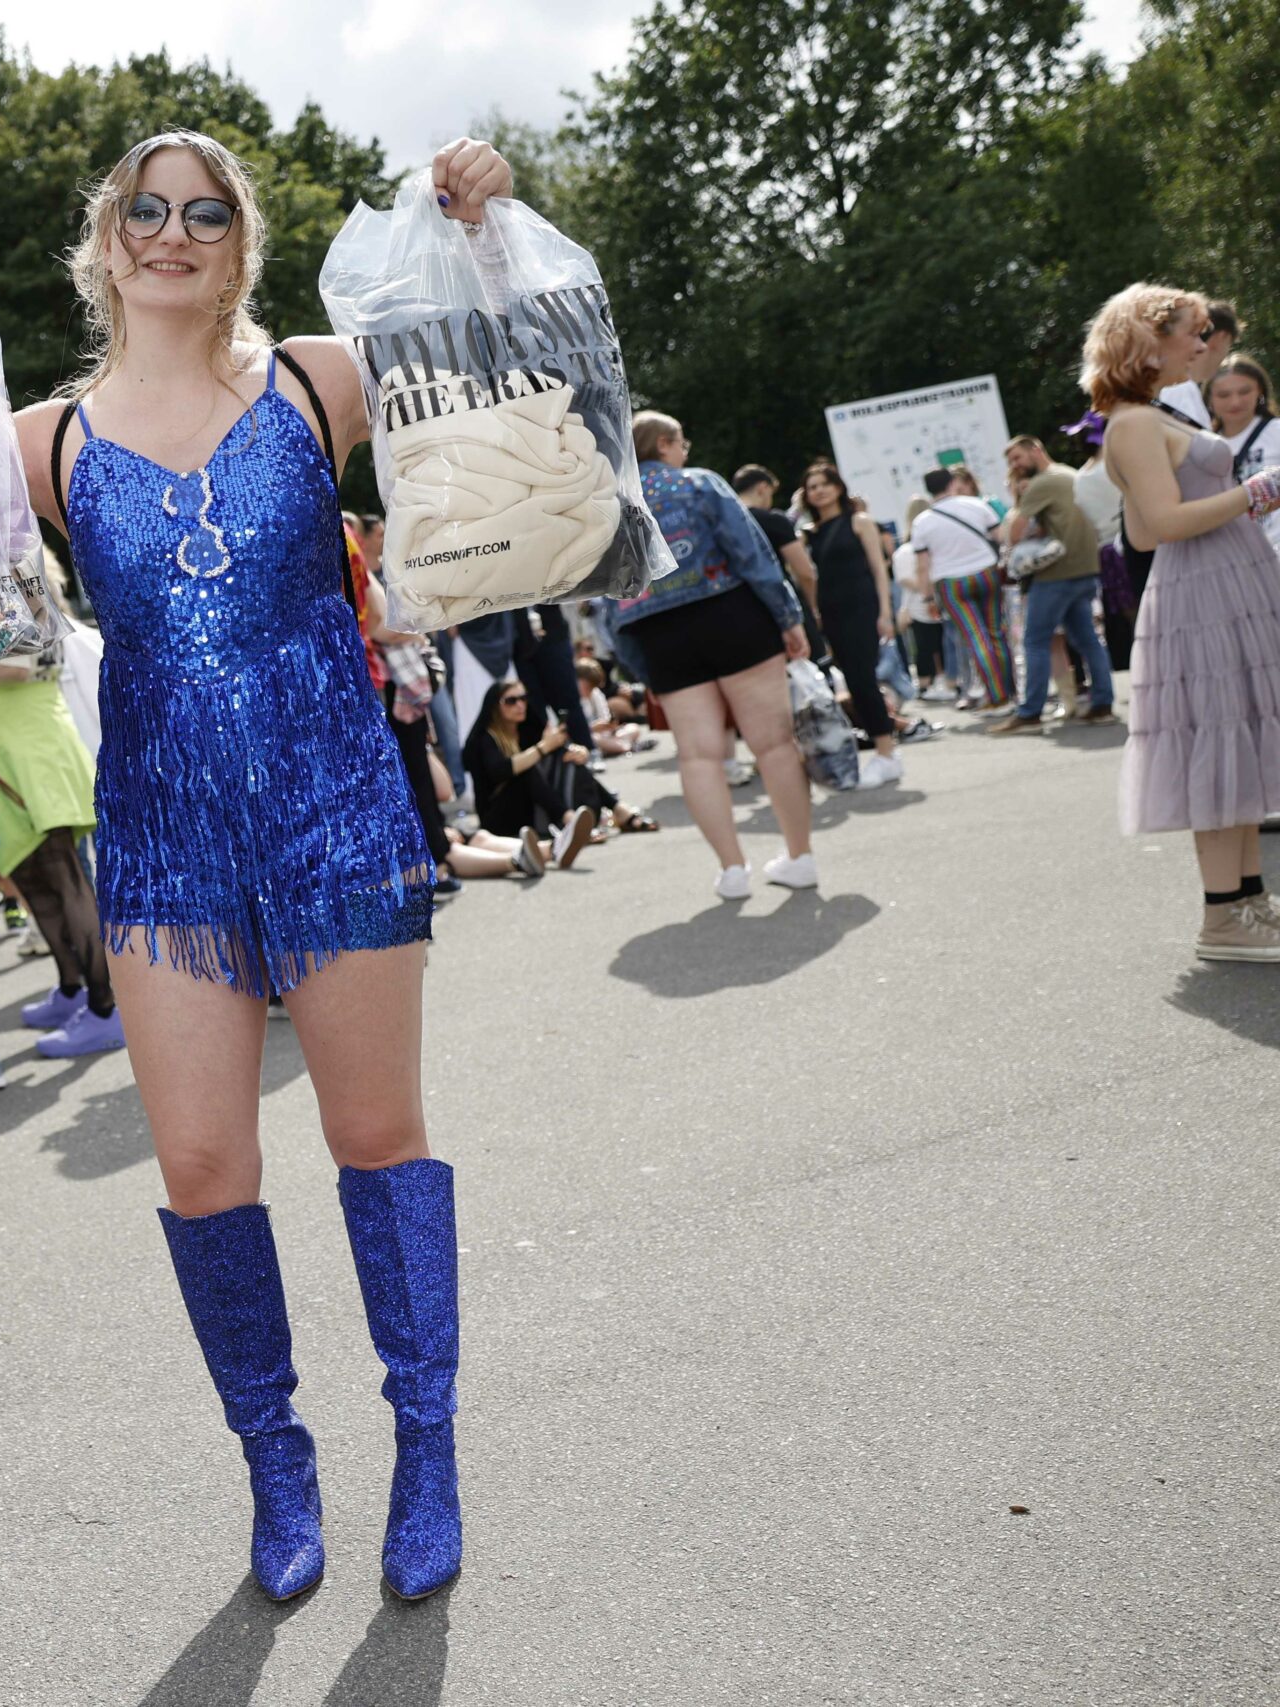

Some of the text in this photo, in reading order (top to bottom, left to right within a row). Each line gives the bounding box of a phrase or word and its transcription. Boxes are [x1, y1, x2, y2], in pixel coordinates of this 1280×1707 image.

[353, 310, 528, 391] TAYLOR
[386, 383, 455, 433] THE
[464, 357, 568, 412] ERAS
[404, 540, 511, 570] TAYLORSWIFT.COM
